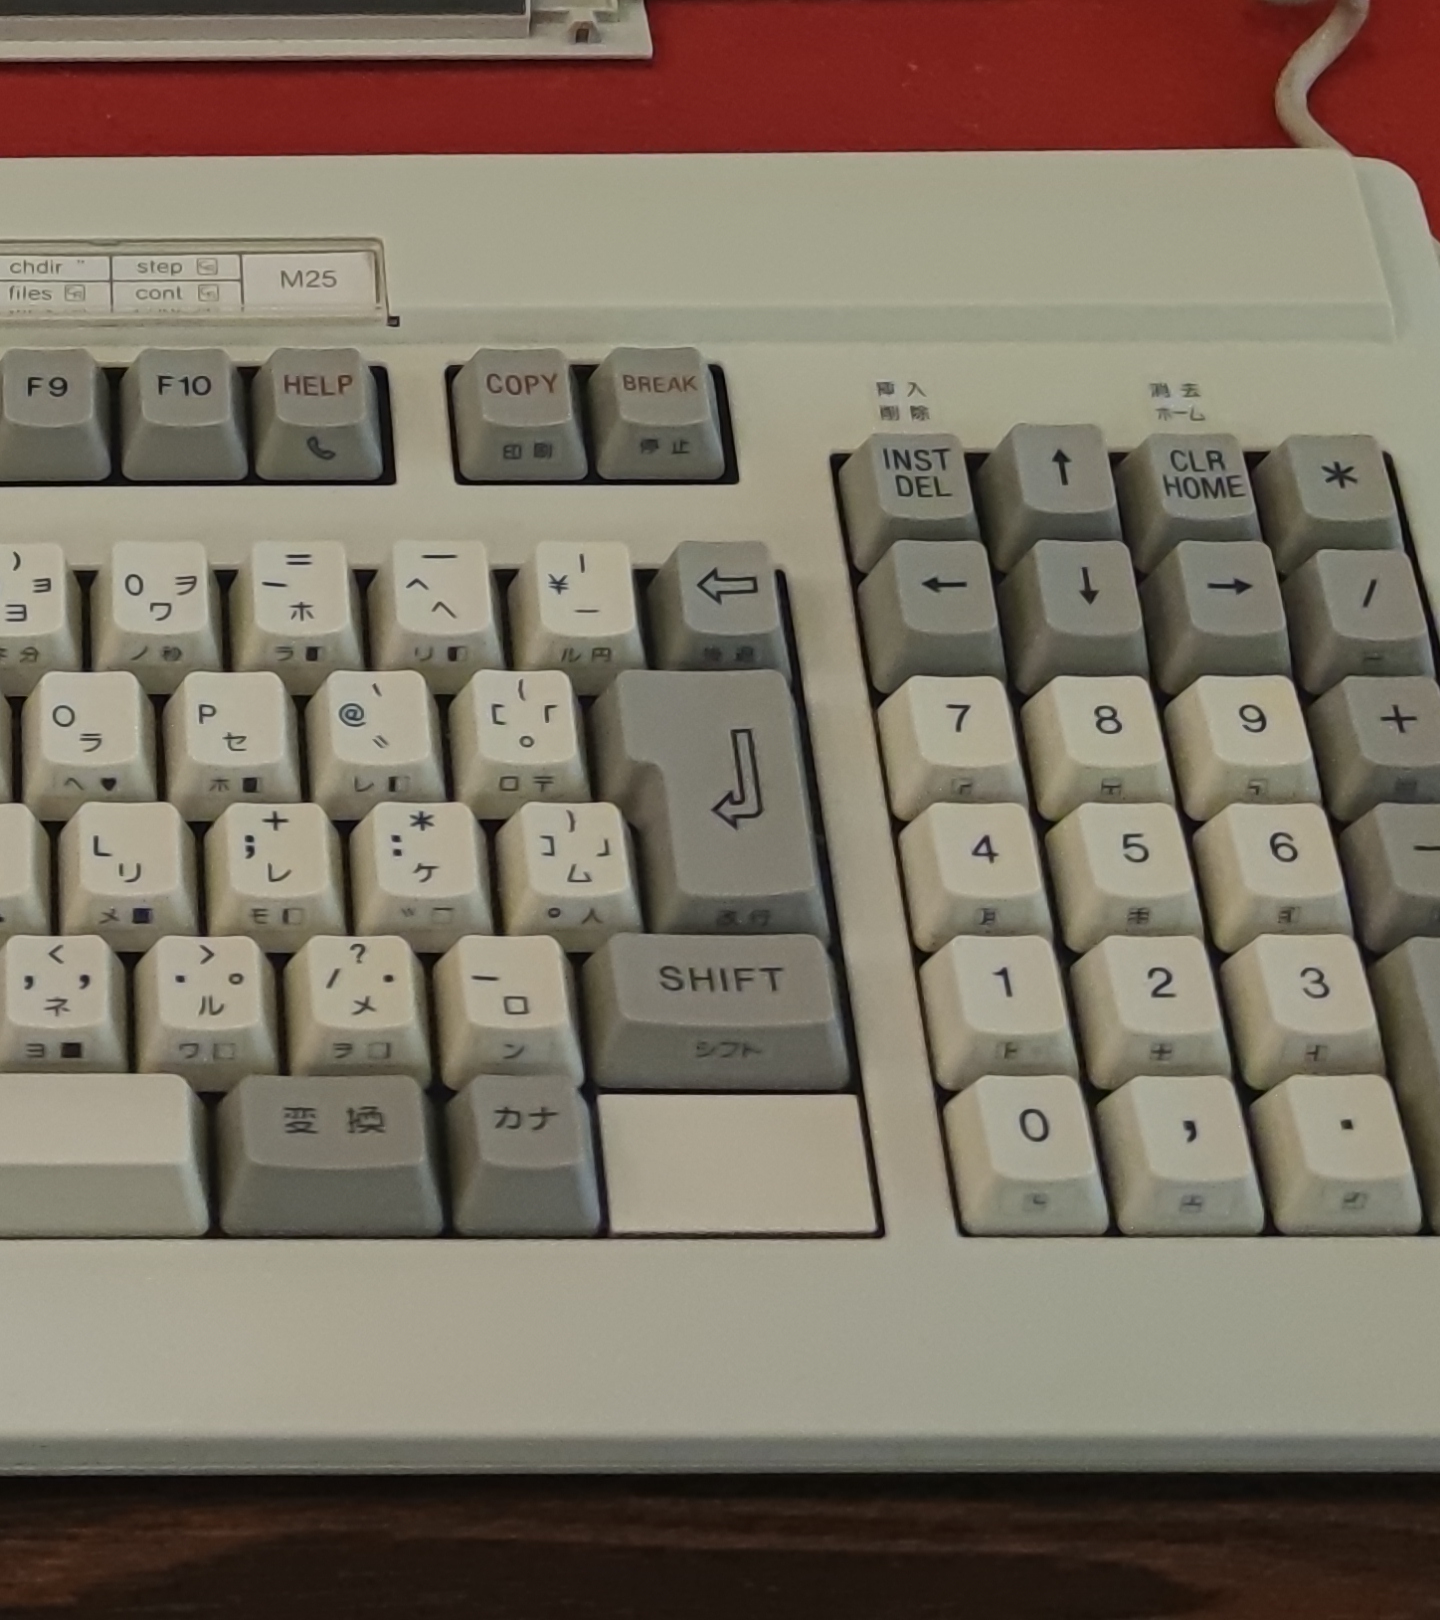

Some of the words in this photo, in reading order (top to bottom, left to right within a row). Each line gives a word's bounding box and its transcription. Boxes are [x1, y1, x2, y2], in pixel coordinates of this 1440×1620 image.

[9, 257, 62, 274] chdir
[135, 258, 183, 278] step
[280, 269, 338, 288] M25
[8, 284, 52, 301] files
[135, 285, 183, 301] cont
[27, 376, 69, 398] F9
[157, 375, 212, 396] F10
[283, 374, 354, 397] HELP
[486, 372, 558, 396] COPY
[622, 374, 698, 394] BREAK
[882, 447, 951, 472] INST
[1169, 449, 1226, 473] CLR
[894, 474, 953, 498] DEL
[1162, 473, 1251, 500] HOME
[124, 573, 144, 597] 0
[51, 704, 76, 728] O
[198, 703, 218, 725] P
[945, 703, 971, 733] 7
[1093, 705, 1123, 735] 8
[1238, 704, 1268, 734] 9
[92, 835, 112, 858] L
[971, 834, 999, 864] 4
[1122, 833, 1150, 864] 5
[1269, 831, 1299, 863] 6
[658, 965, 784, 993] SHIFT
[993, 966, 1013, 998] 1
[1147, 966, 1177, 999] 2
[1300, 966, 1331, 999] 3
[283, 1105, 386, 1135] 変換
[493, 1106, 559, 1132] カナ
[1018, 1108, 1050, 1143] 0
